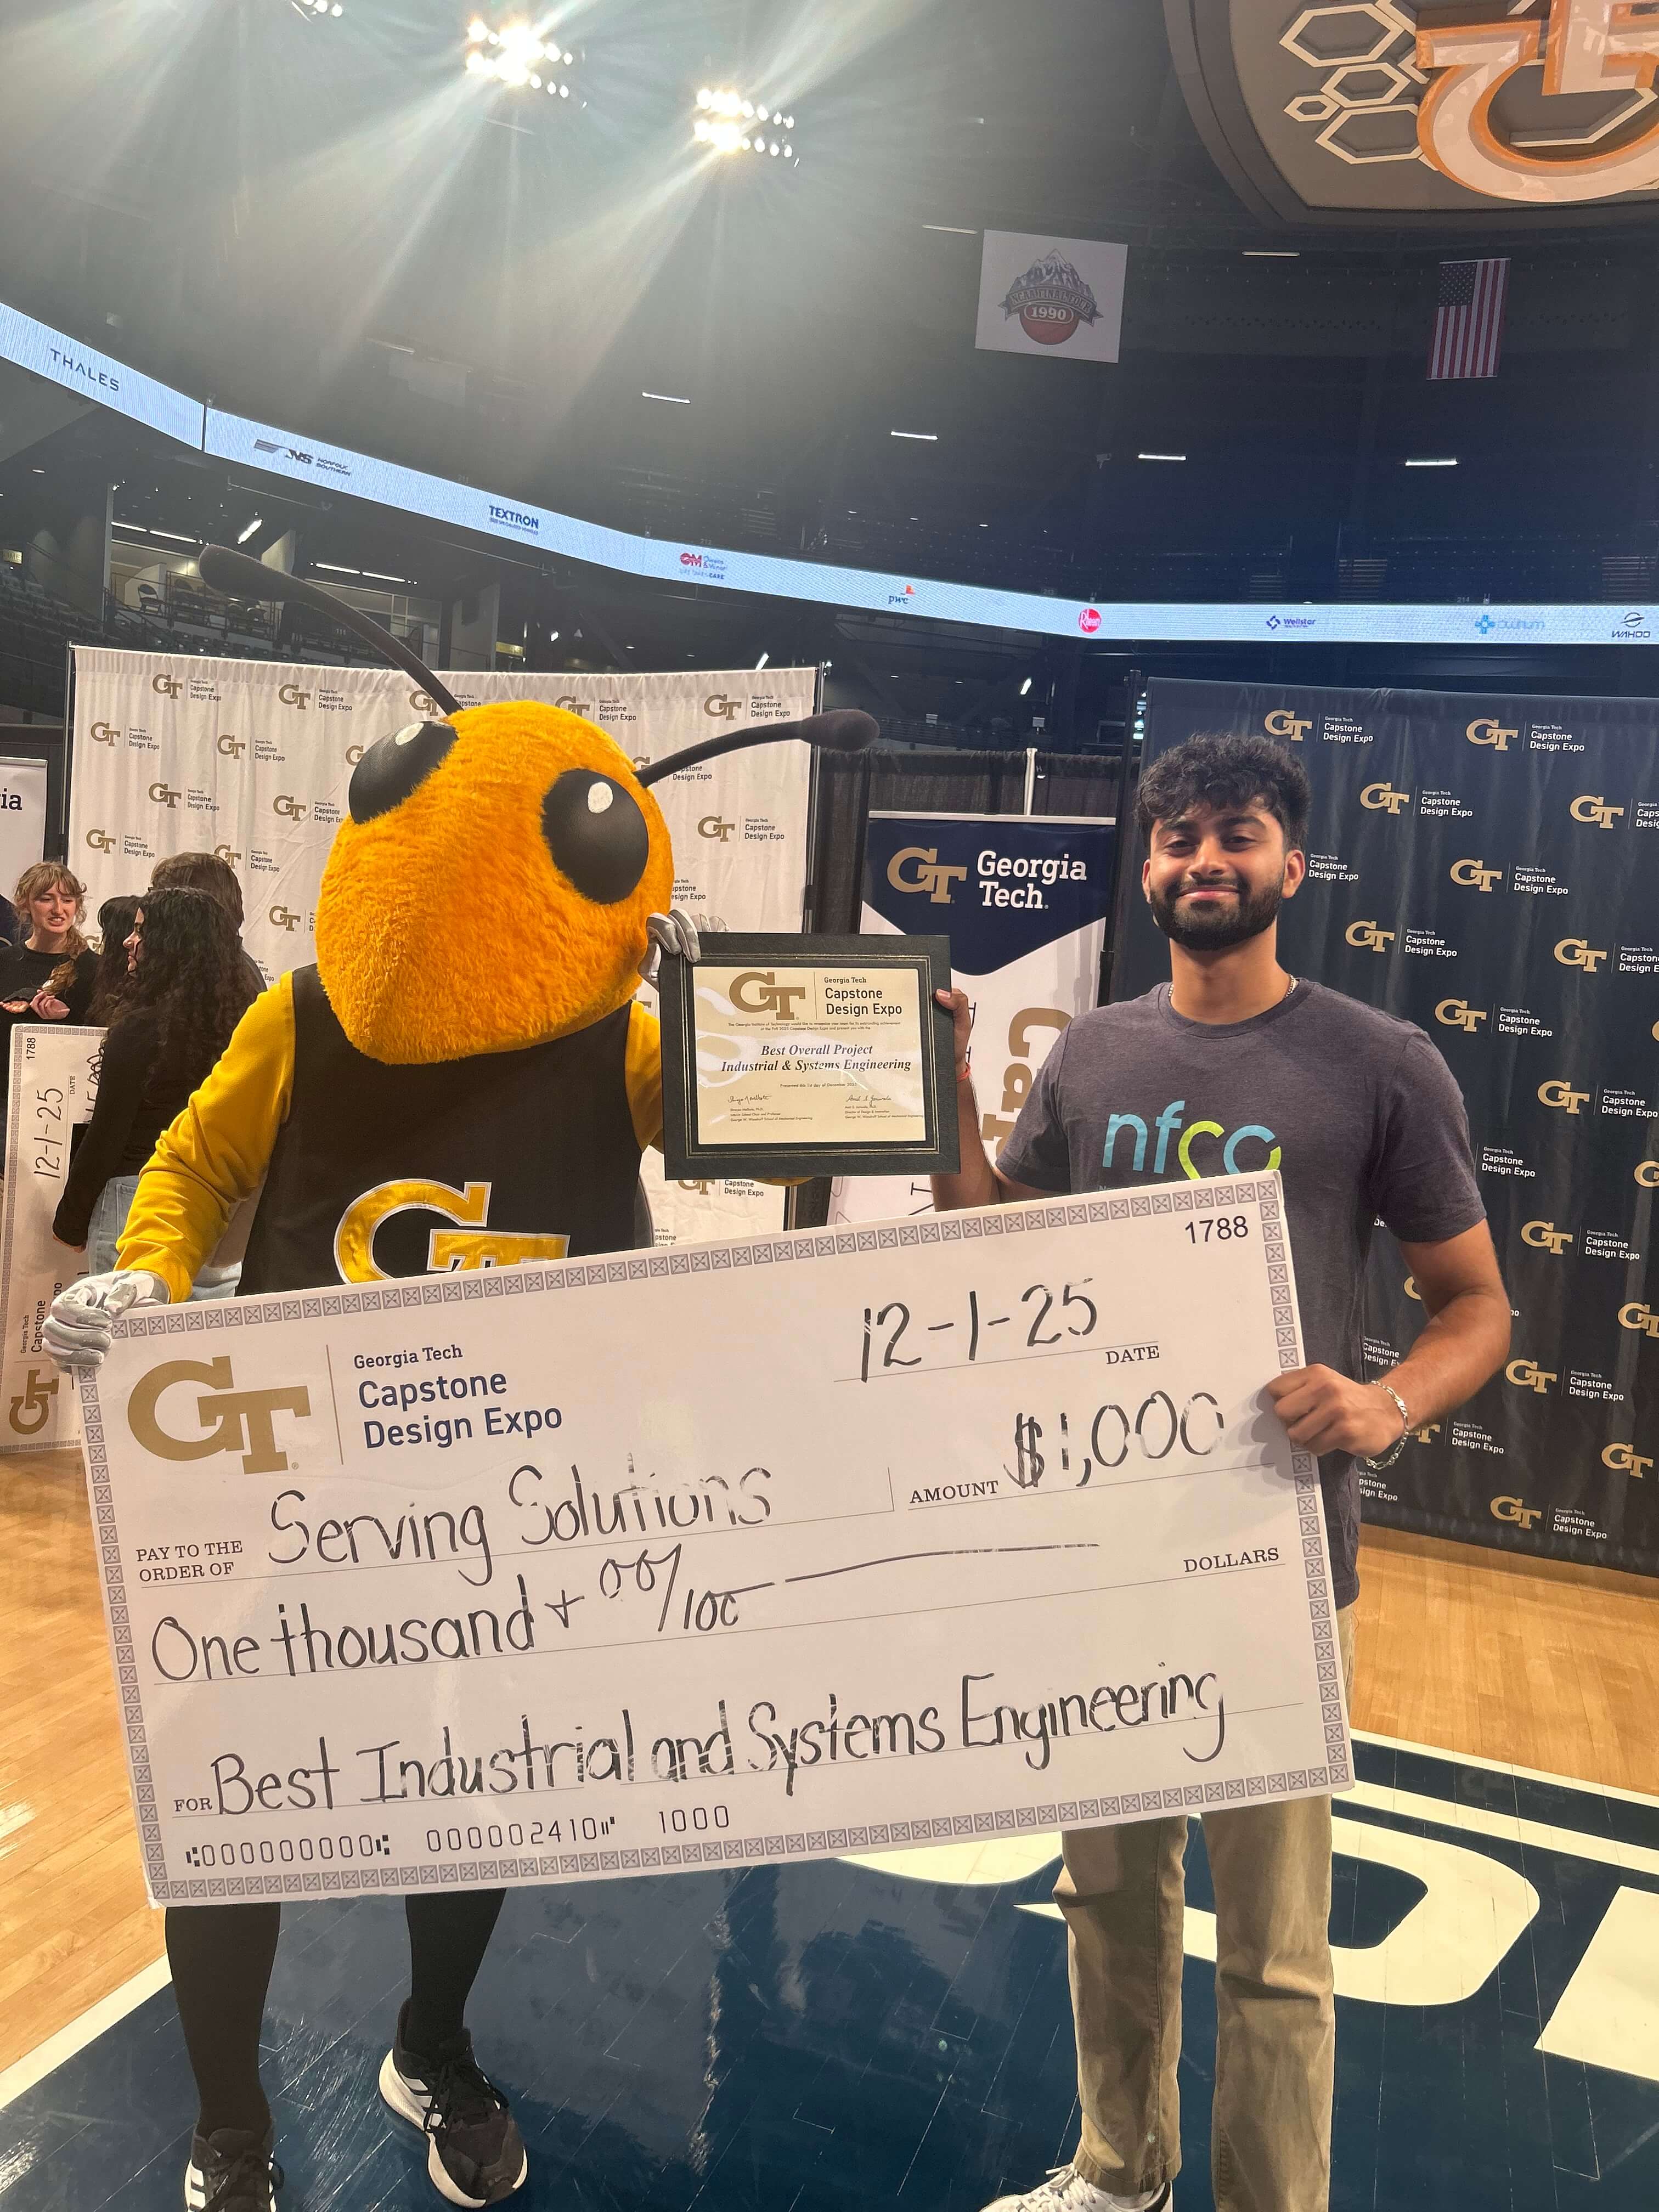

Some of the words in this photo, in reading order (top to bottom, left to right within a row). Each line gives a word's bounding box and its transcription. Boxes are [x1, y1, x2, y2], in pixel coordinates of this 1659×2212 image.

[1031, 307, 1066, 321] 1990
[50, 348, 119, 392] THALES
[489, 505, 539, 529] TEXTRON
[888, 595, 909, 604] pwc
[1611, 630, 1651, 639] WAHOO
[278, 684, 311, 710] GT
[318, 694, 344, 703] Capstone
[318, 702, 337, 711] Design
[338, 703, 353, 712] Expo
[704, 694, 742, 721] GT
[1264, 709, 1313, 741] GT
[1324, 723, 1363, 733] Capstone
[1465, 718, 1519, 751] GT
[1323, 732, 1352, 743] Design
[1353, 735, 1374, 744] Expo
[1530, 741, 1560, 752] Design
[1562, 743, 1585, 753] Expo
[1531, 731, 1572, 743] Capstone
[697, 816, 735, 842] GT
[86, 829, 116, 854] GT
[124, 840, 148, 849] Capstone
[124, 848, 142, 856] Design
[143, 850, 155, 858] Expo
[887, 847, 968, 905] GT
[977, 850, 1087, 886] Georgia
[1308, 870, 1337, 881] Design
[1339, 872, 1359, 882] Expo
[1309, 860, 1348, 871] Capstone
[979, 881, 1038, 909] Tech
[1345, 920, 1395, 953] GT
[1406, 935, 1446, 946] Capstone
[1404, 945, 1434, 956] Design
[1436, 947, 1458, 958] Expo
[729, 972, 806, 1020] GT
[825, 988, 883, 1001] Capstone
[826, 1003, 871, 1017] Design
[873, 1003, 902, 1017] Expo
[1434, 998, 1487, 1032] GT
[1499, 1014, 1541, 1025] Capstone
[1498, 1024, 1528, 1036] Design
[1530, 1027, 1553, 1038] Expo
[26, 1037, 36, 1060] 1788
[760, 1045, 786, 1056] Best
[789, 1044, 830, 1056] Overall
[834, 1044, 873, 1057] Project
[720, 1060, 778, 1072] Industrial
[782, 1060, 791, 1070] &
[795, 1060, 840, 1073] Systems
[844, 1058, 911, 1072] Engineering
[33, 1088, 64, 1179] 12-1-25
[724, 1180, 754, 1188] Capstone
[724, 1188, 746, 1196] Design
[748, 1189, 764, 1198] Expo
[1183, 1215, 1250, 1245] 1788
[1521, 1220, 1573, 1255] GT
[1585, 1237, 1629, 1249] Capstone
[1585, 1246, 1616, 1259] Design
[1619, 1250, 1640, 1261] Expo
[31, 1300, 46, 1352] Capstone
[861, 1276, 1098, 1384] 12-1-25
[20, 1332, 29, 1353] Georgia
[353, 1350, 420, 1370] Georgia
[422, 1344, 464, 1363] Tech
[1105, 1345, 1160, 1365] DATE
[1505, 1359, 1558, 1393] GT
[1570, 1376, 1612, 1390] Capstone
[9, 1369, 60, 1435] GT
[358, 1372, 508, 1412] Capstone
[1568, 1386, 1600, 1399] Design
[1602, 1391, 1624, 1402] Expo
[127, 1355, 312, 1475] GT
[364, 1413, 474, 1450] Design
[484, 1406, 563, 1437] Expo
[1003, 1390, 1225, 1489] $1,000
[909, 1479, 1000, 1504] AMOUNT
[268, 1489, 494, 1586] Serving
[508, 1451, 772, 1544] Solutions
[1489, 1495, 1542, 1530] GT
[1554, 1514, 1595, 1528] Capstone
[1553, 1523, 1583, 1537] Design
[1585, 1527, 1607, 1540] Expo
[136, 1547, 171, 1563] PAY
[174, 1544, 200, 1559] TO
[204, 1539, 244, 1555] THE
[1183, 1547, 1280, 1573] DOLLARS
[139, 1564, 205, 1583] ORDER
[208, 1561, 235, 1576] OF
[151, 1616, 261, 1681] One
[269, 1573, 535, 1677] thousand
[210, 1736, 340, 1815] Best
[356, 1709, 635, 1803] Industrial
[651, 1699, 735, 1782] and
[747, 1693, 945, 1796] Systems
[961, 1661, 1225, 1771] Engineering
[174, 1797, 213, 1813] FOR
[658, 1805, 730, 1834] 1000
